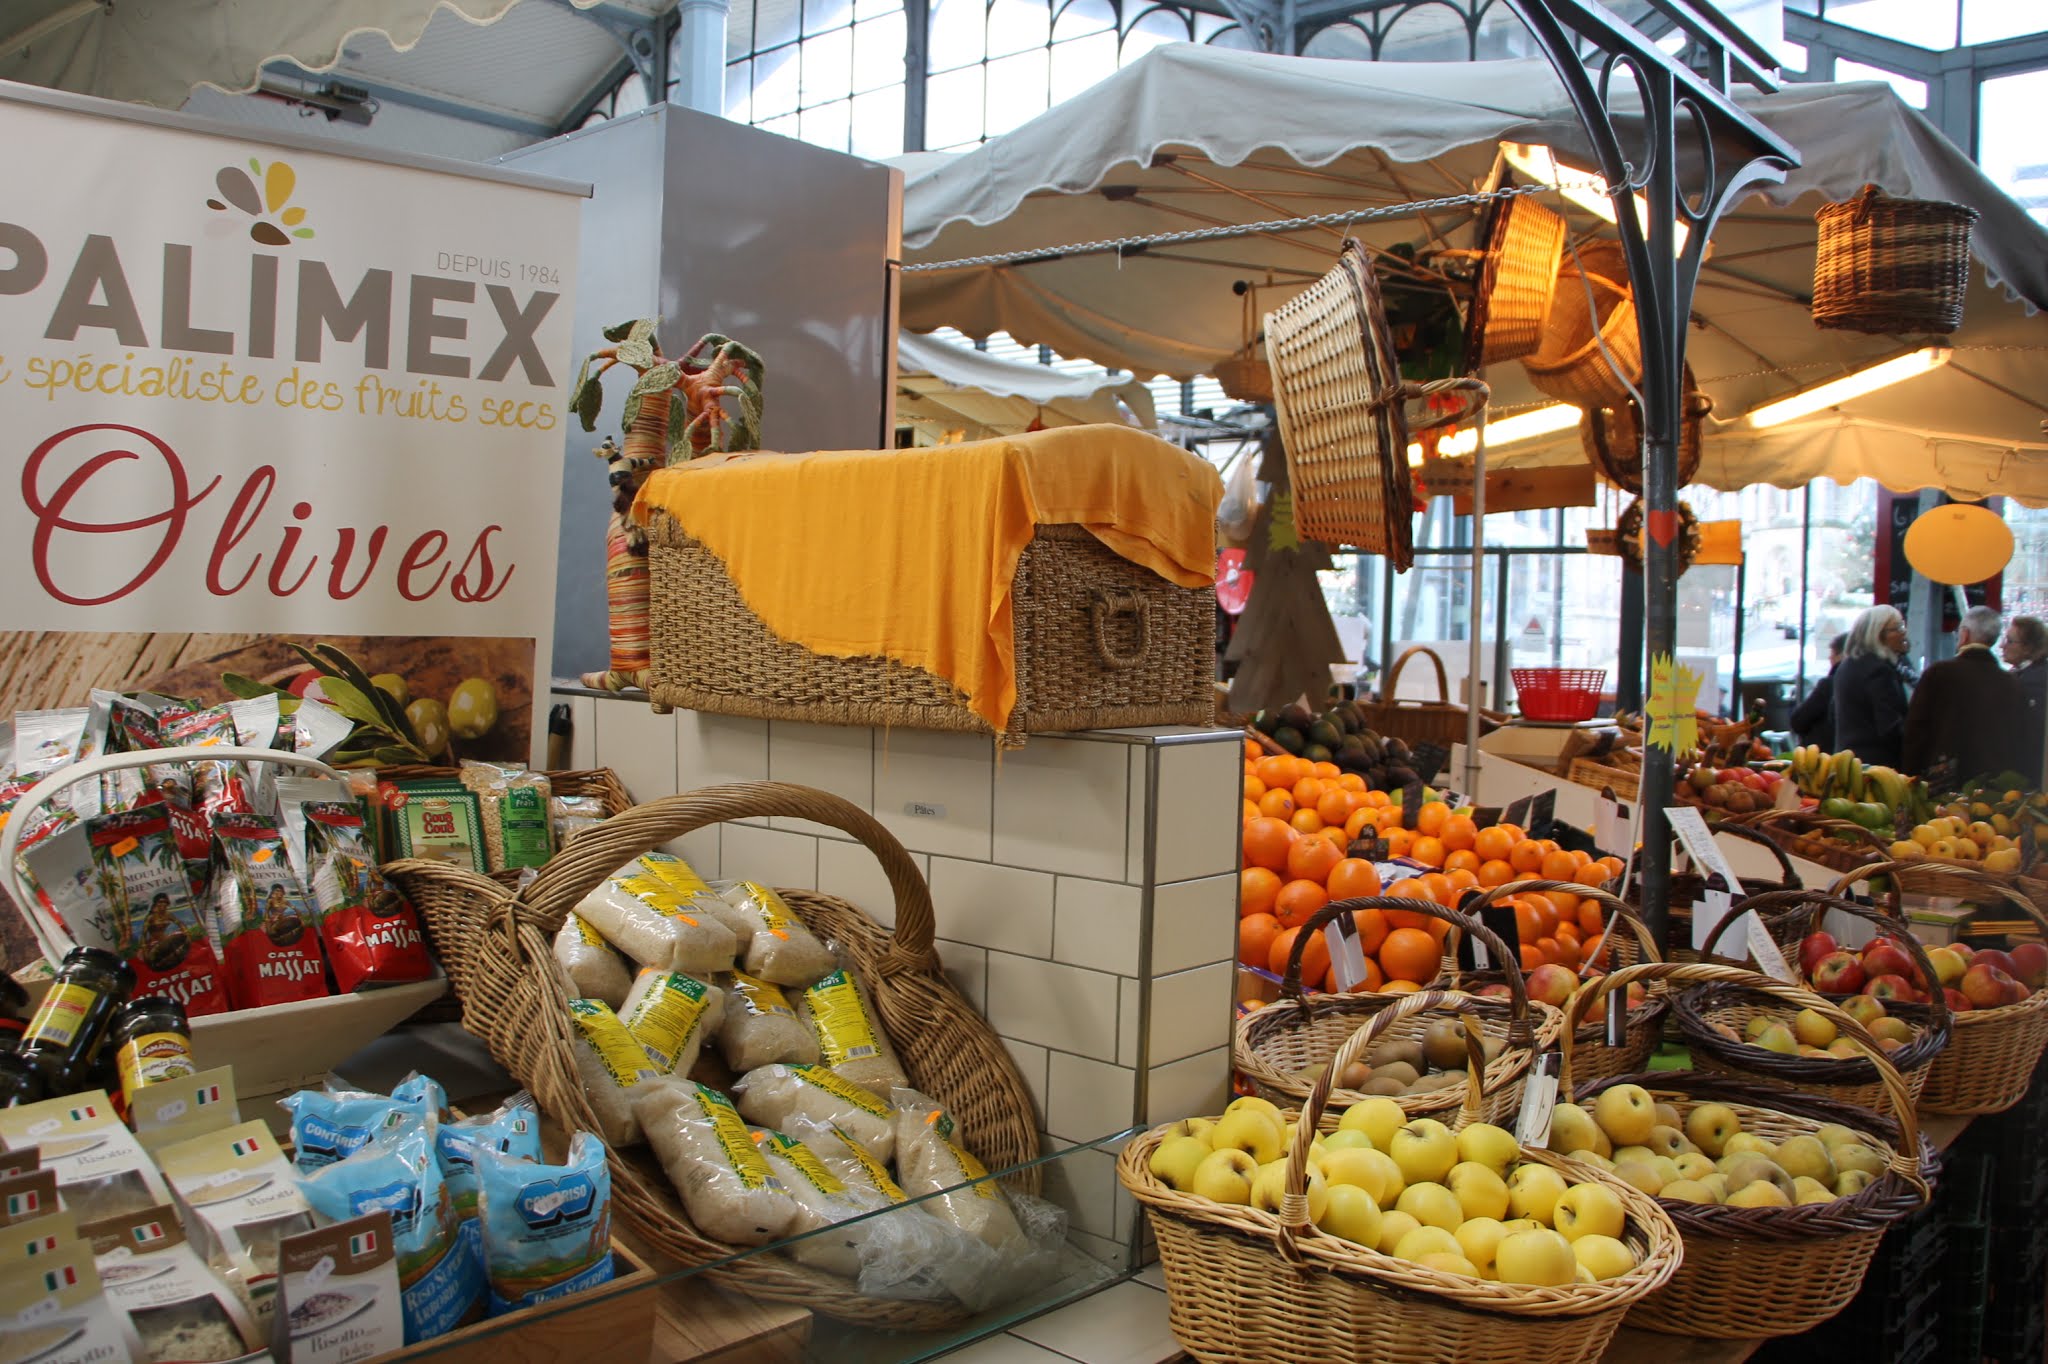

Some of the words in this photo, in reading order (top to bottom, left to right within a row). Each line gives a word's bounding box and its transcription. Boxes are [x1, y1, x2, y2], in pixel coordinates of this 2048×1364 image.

[437, 251, 512, 279] DEPUIS
[518, 262, 561, 285] 1984
[23, 350, 265, 404] spécialiste
[274, 366, 344, 412] des
[354, 373, 468, 425] fruits
[479, 399, 556, 431] secs
[20, 423, 515, 606] Olives
[122, 876, 175, 894] RIENTAL
[364, 927, 423, 949] MASSAT
[267, 950, 305, 959] CAFE
[147, 970, 192, 989] CAFE
[258, 958, 321, 982] MASSAT
[138, 974, 214, 1006] ASSAT
